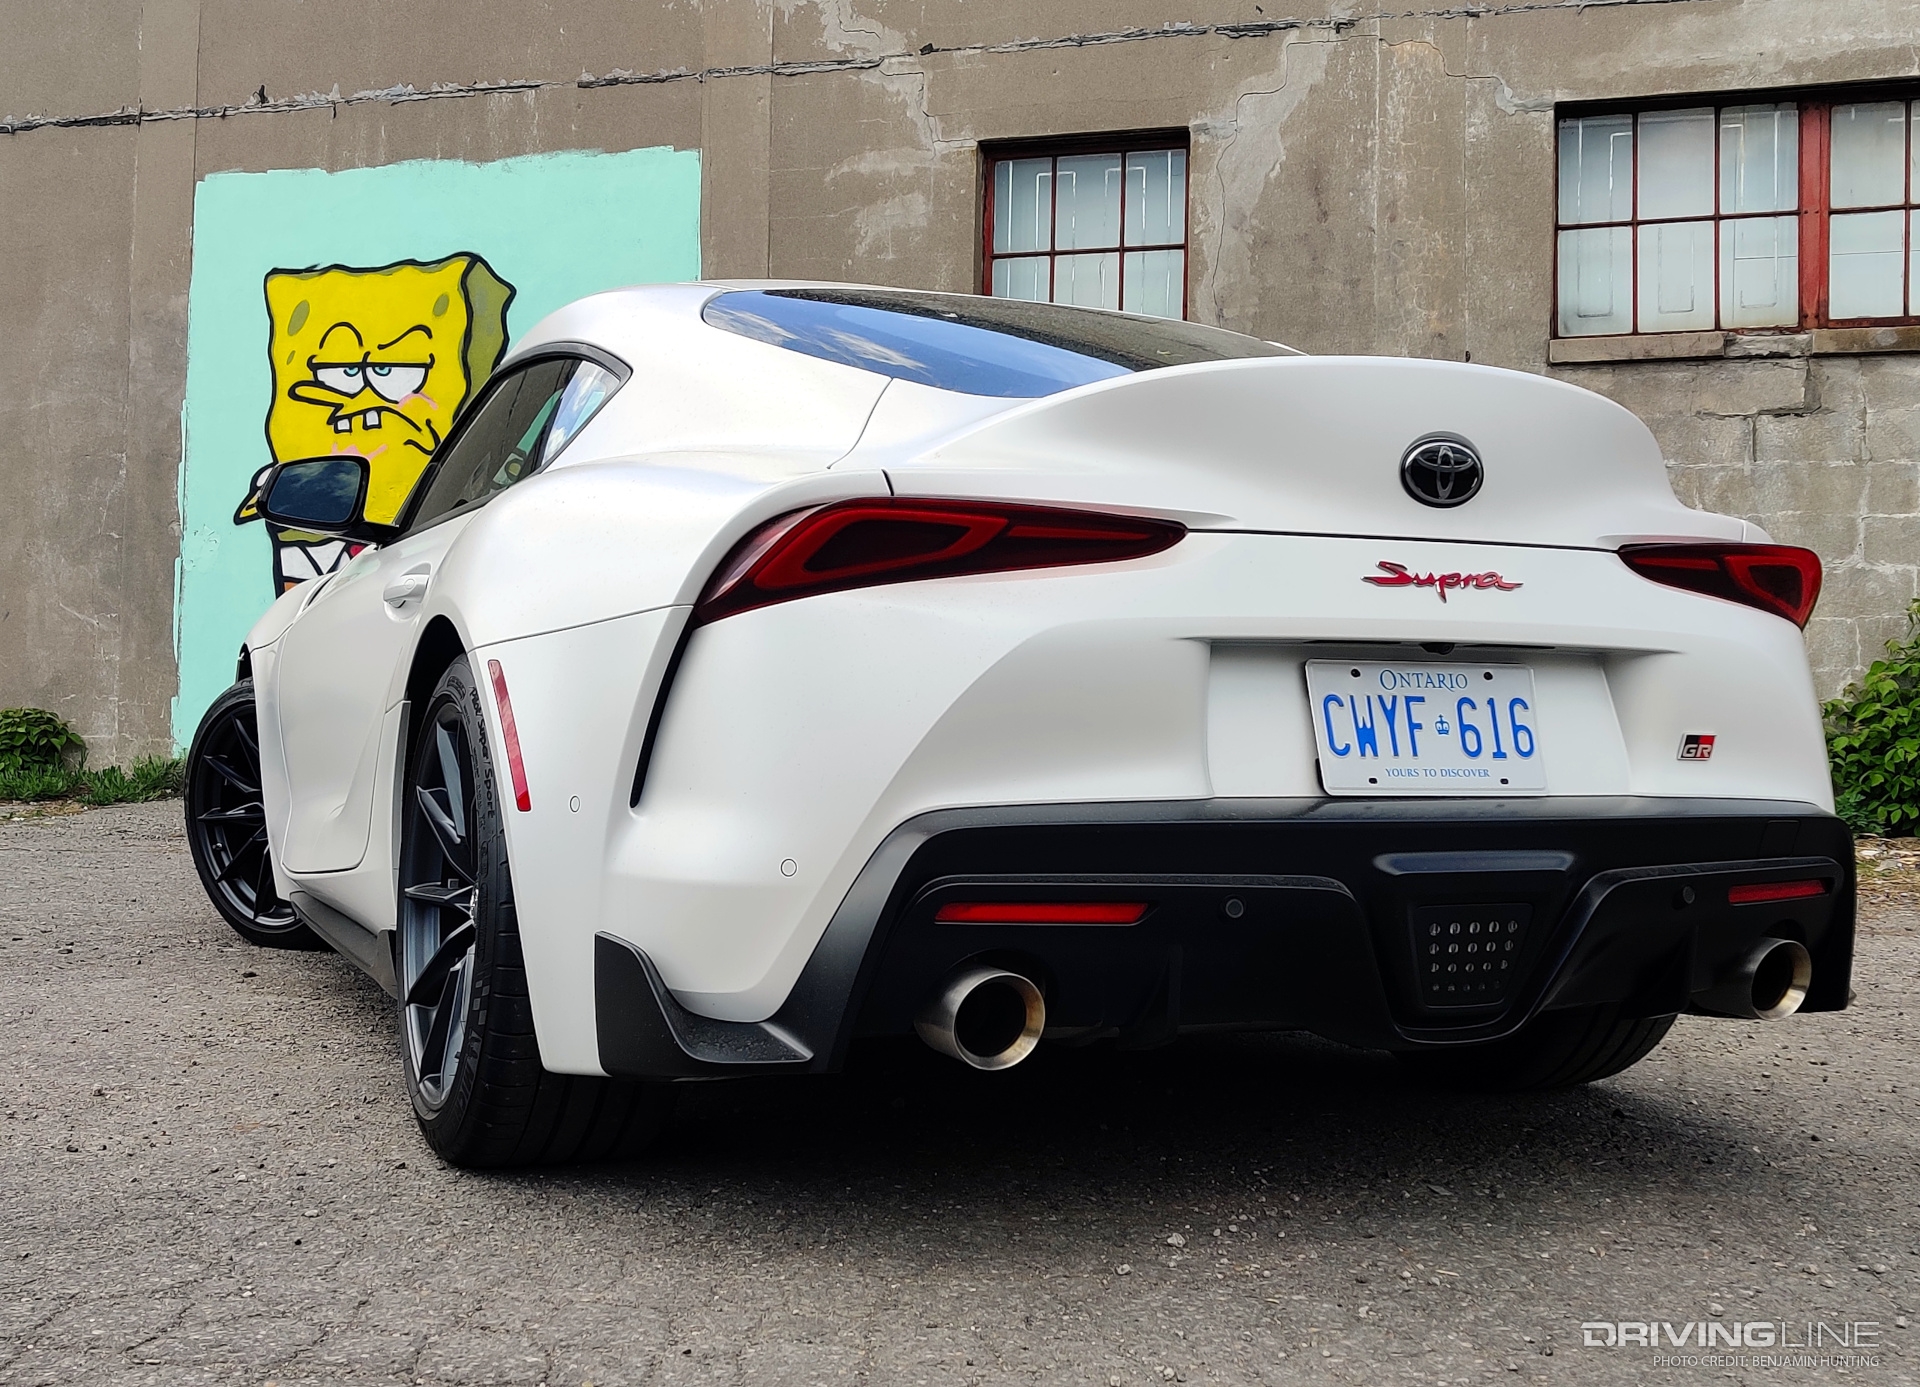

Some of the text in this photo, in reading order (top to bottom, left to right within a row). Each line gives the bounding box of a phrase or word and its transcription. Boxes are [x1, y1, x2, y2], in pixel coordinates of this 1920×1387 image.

[1361, 560, 1524, 604] Supra
[1379, 669, 1469, 693] ONTARIO
[1322, 693, 1536, 759] CWYF 616
[483, 767, 495, 819] Sport
[1385, 768, 1491, 779] YOURS TO DISCOVER
